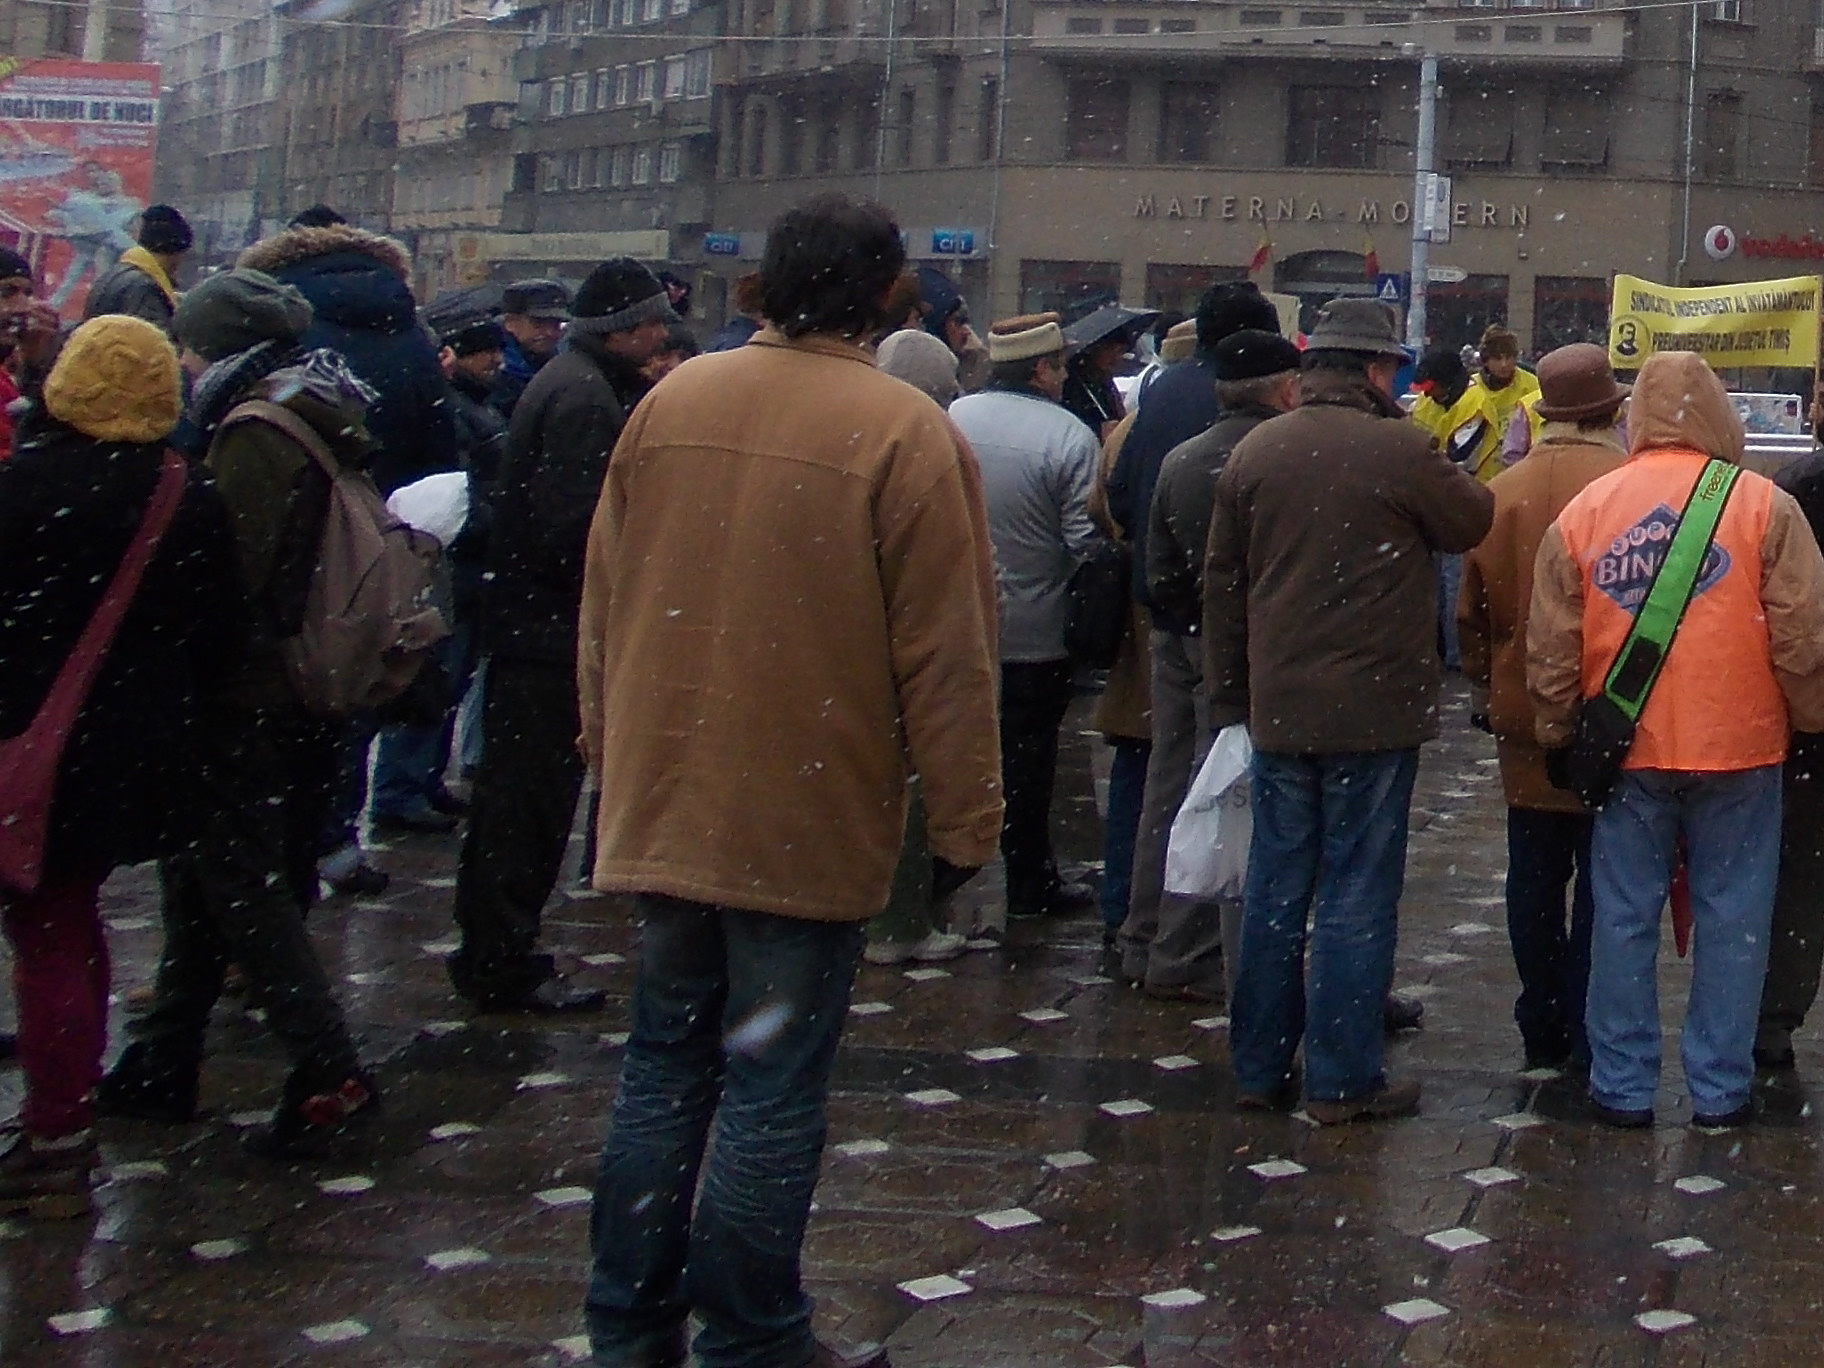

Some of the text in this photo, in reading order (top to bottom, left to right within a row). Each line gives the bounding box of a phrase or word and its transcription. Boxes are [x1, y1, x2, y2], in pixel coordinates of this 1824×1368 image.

[1134, 195, 1322, 221] MATERNA
[1357, 198, 1530, 227] MOERN
[1675, 296, 1732, 317] INDEPENDENT
[1735, 296, 1747, 313] AL
[1610, 521, 1676, 556] SUP
